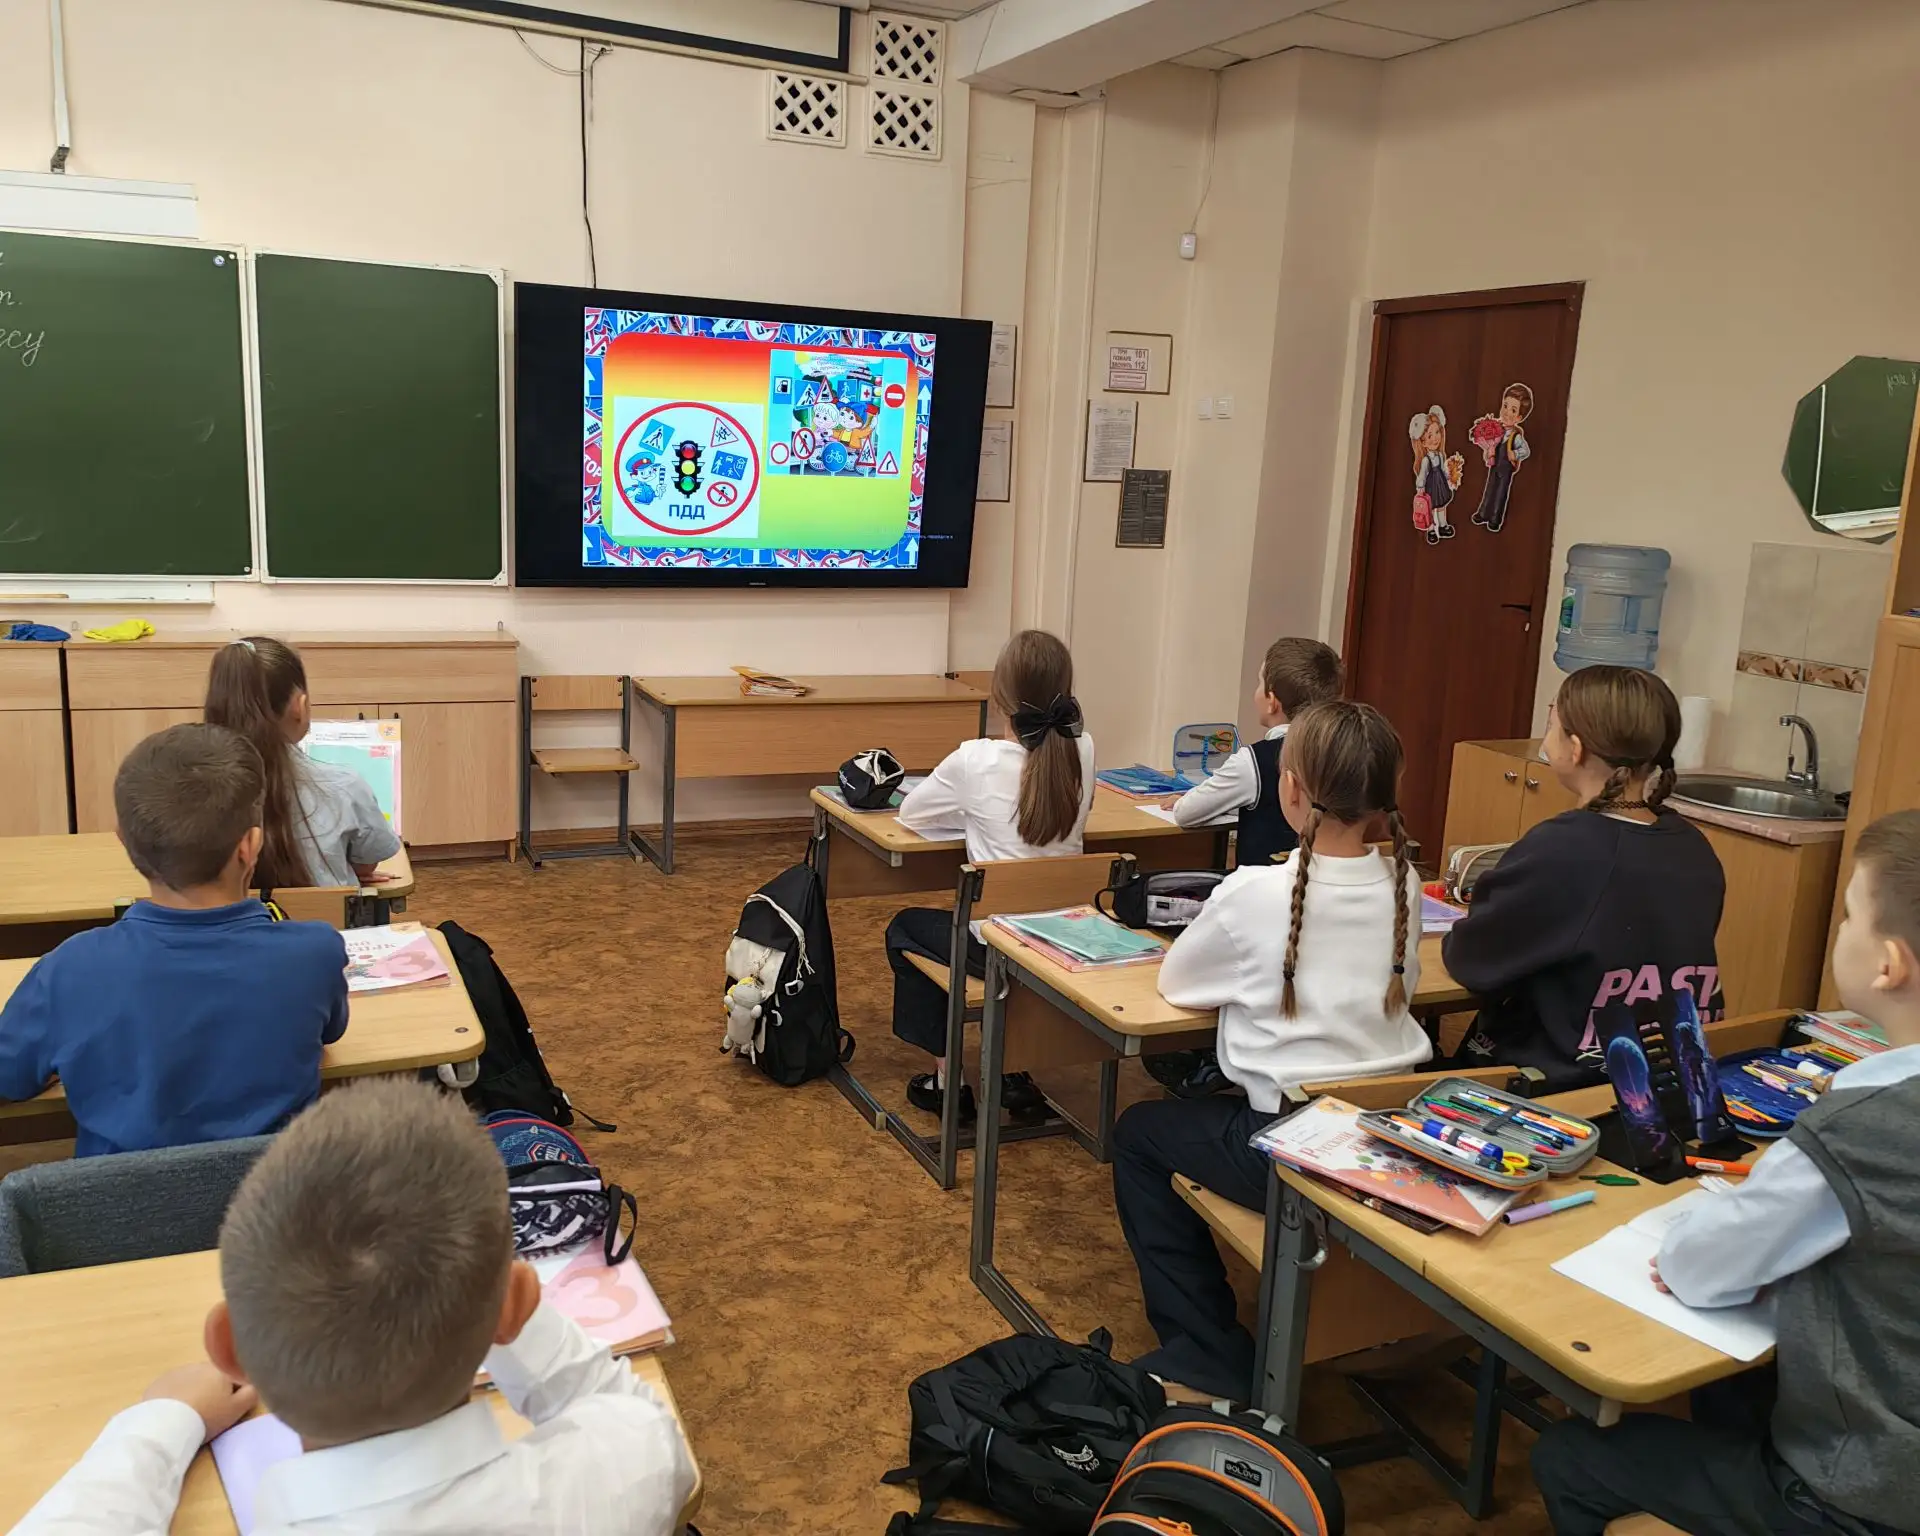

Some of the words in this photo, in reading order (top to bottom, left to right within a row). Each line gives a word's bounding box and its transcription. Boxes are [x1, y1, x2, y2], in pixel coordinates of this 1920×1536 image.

[1135, 349, 1146, 359] 101
[1134, 360, 1146, 370] 112
[668, 504, 706, 520] ПДД
